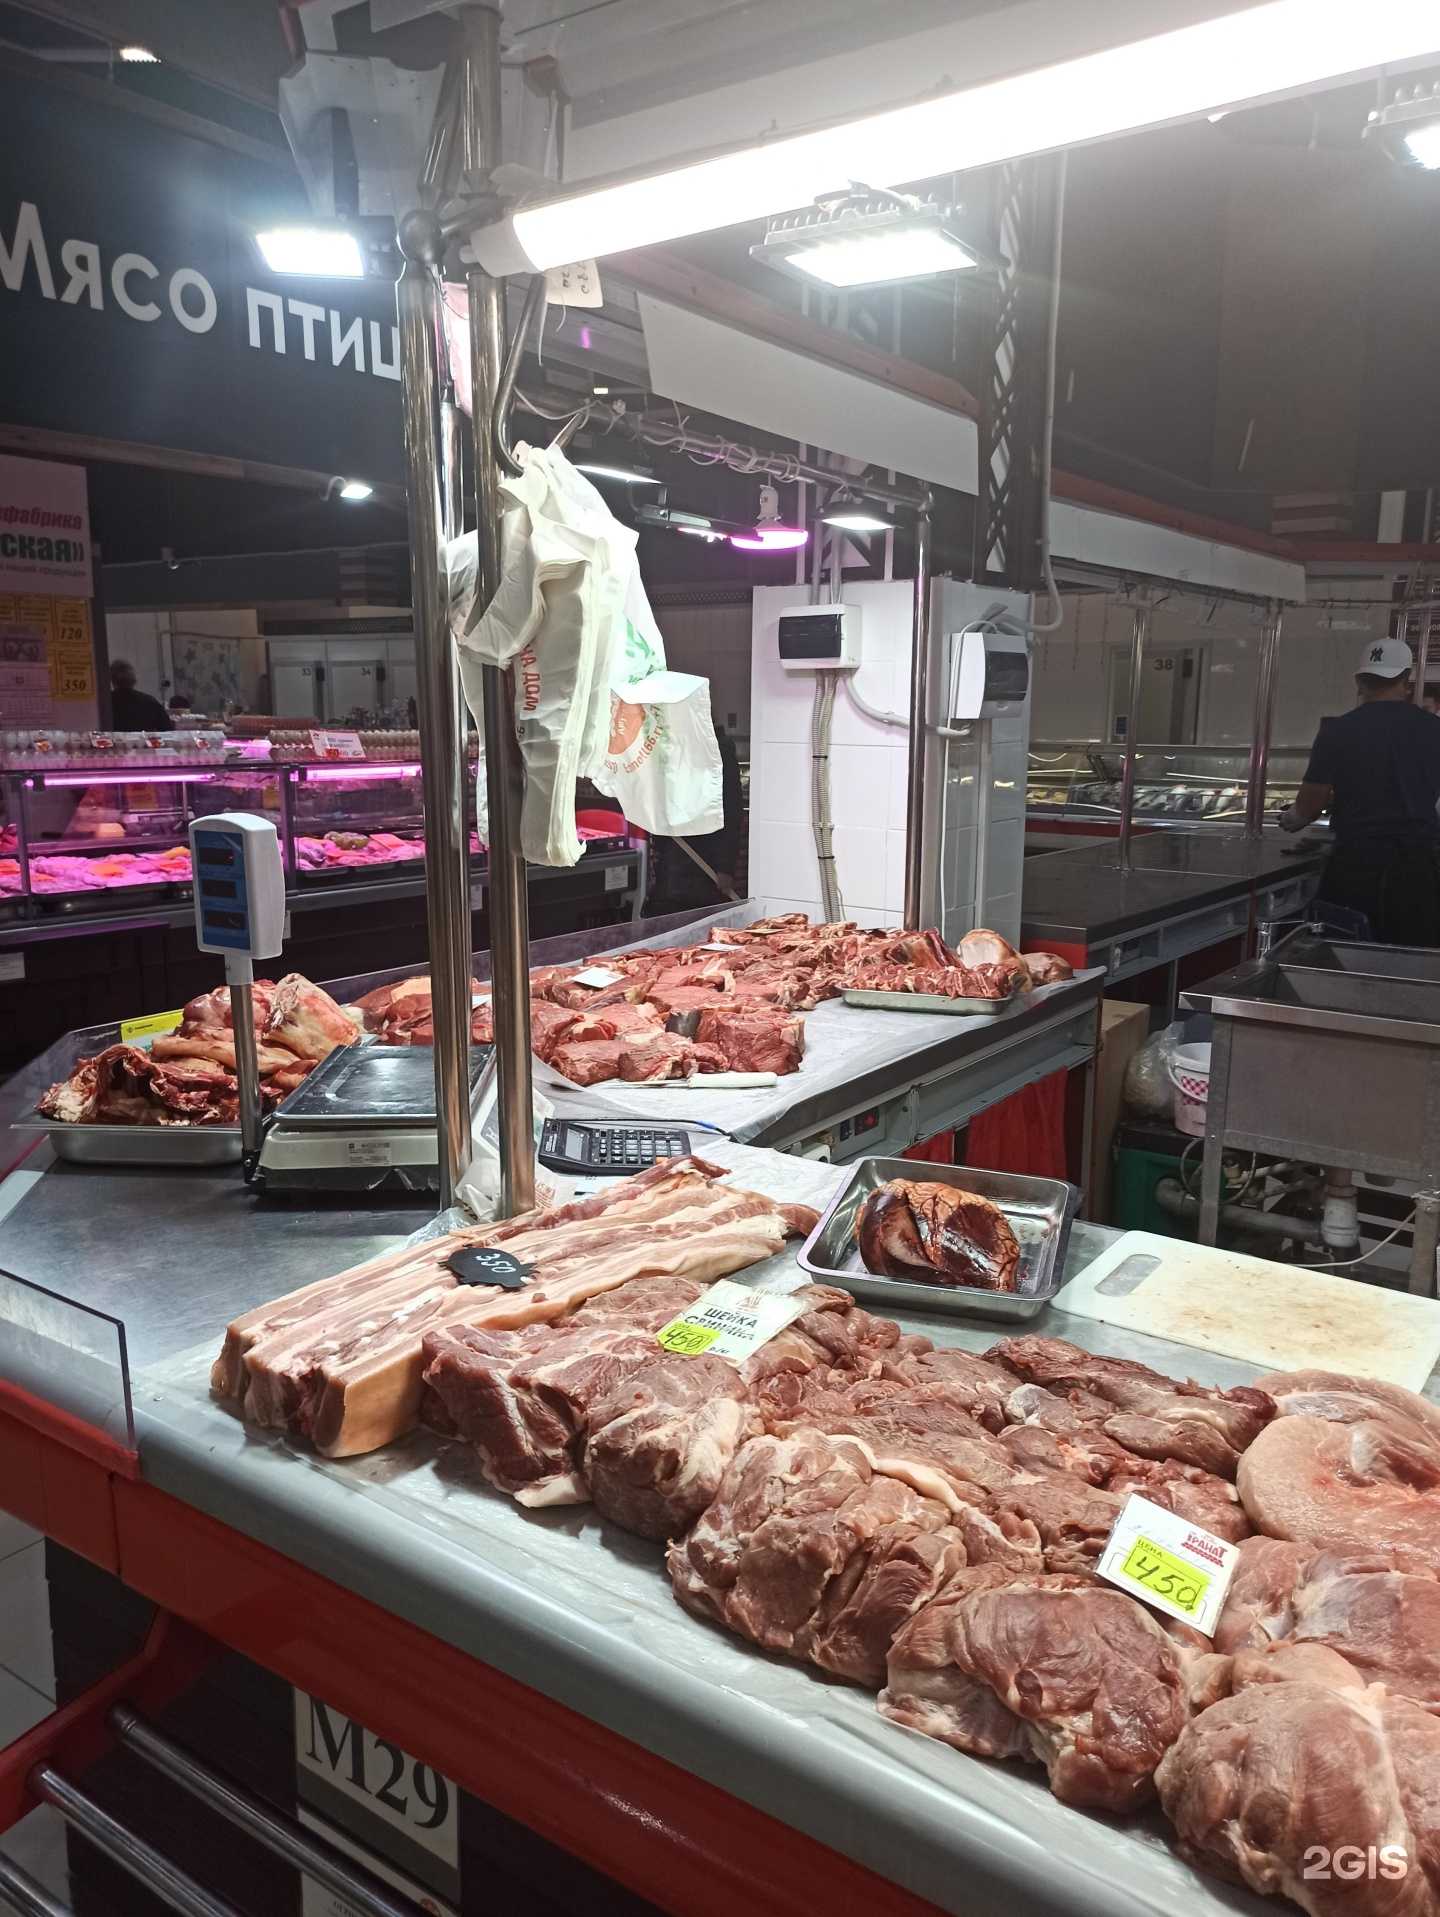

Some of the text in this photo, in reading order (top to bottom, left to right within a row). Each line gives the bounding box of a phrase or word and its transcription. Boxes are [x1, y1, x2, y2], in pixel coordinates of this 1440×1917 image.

[1153, 658, 1174, 671] 38
[522, 672, 541, 711] ДОМ
[474, 1253, 517, 1273] 350
[704, 1307, 759, 1330] ШЕЙКА
[664, 1328, 705, 1351] 450
[1135, 1555, 1200, 1605] 450
